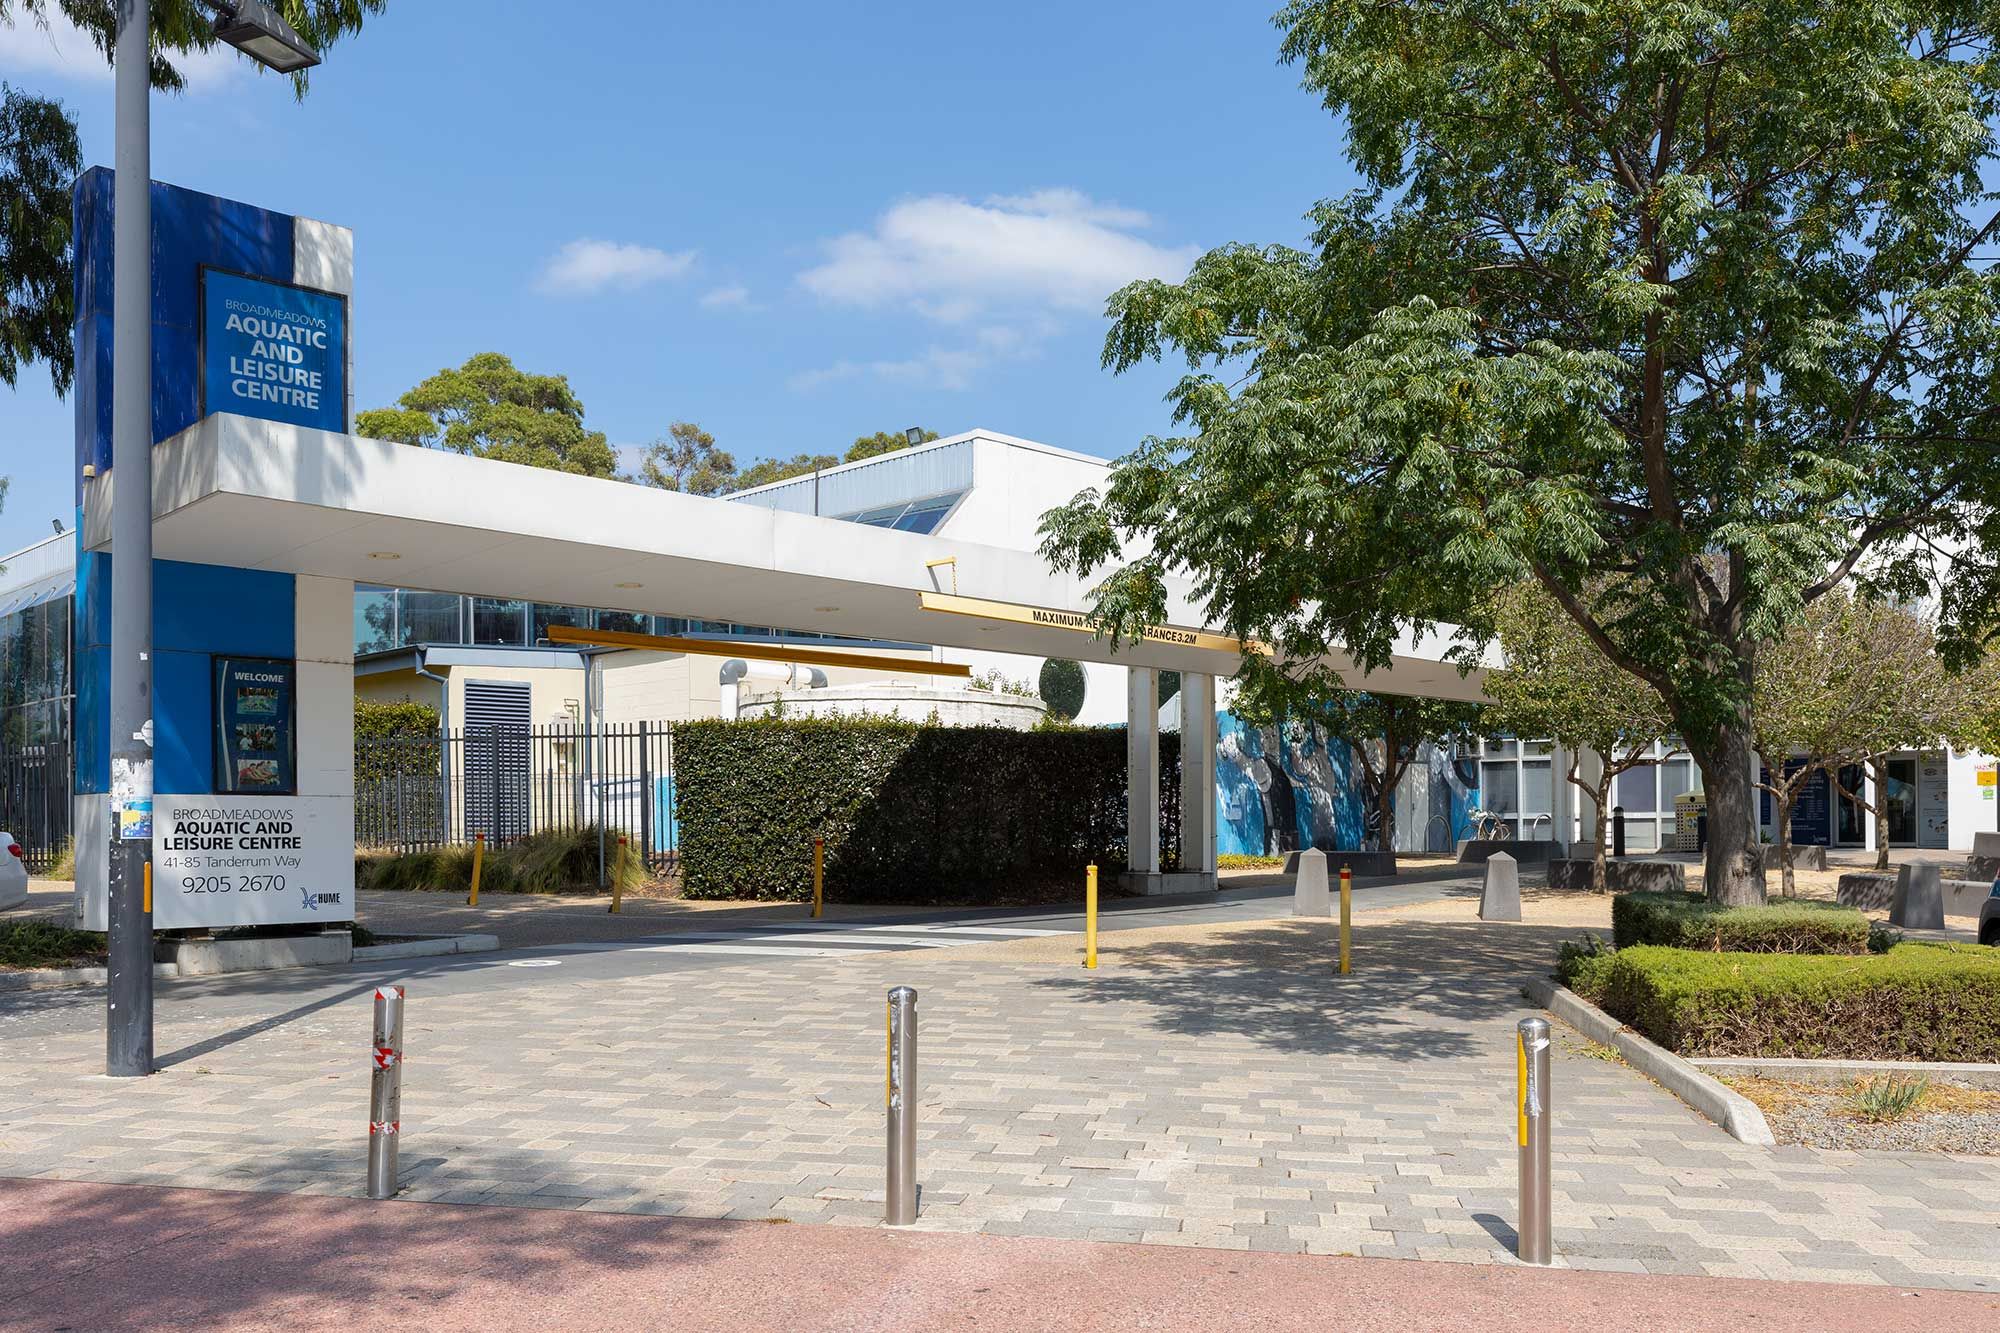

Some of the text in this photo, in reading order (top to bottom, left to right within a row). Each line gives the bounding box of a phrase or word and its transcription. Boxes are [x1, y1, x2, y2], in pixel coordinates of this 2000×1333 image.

[225, 299, 327, 329] BROADMEADOWS
[225, 313, 327, 350] AQUATIC
[251, 339, 304, 364] AND
[230, 356, 322, 390] LEISURE
[231, 378, 320, 410] CENTRE
[1032, 610, 1083, 629] MAXIMUM
[234, 671, 285, 683] WELCOME
[173, 808, 293, 820] BROADMEADOWS
[174, 821, 293, 836] AQUATIC AND
[164, 837, 301, 851] LEISURE CENTRE
[164, 855, 301, 869] 41-85 Tanderrum Way
[182, 875, 286, 894] 9205 2670
[318, 893, 340, 903] HUME
